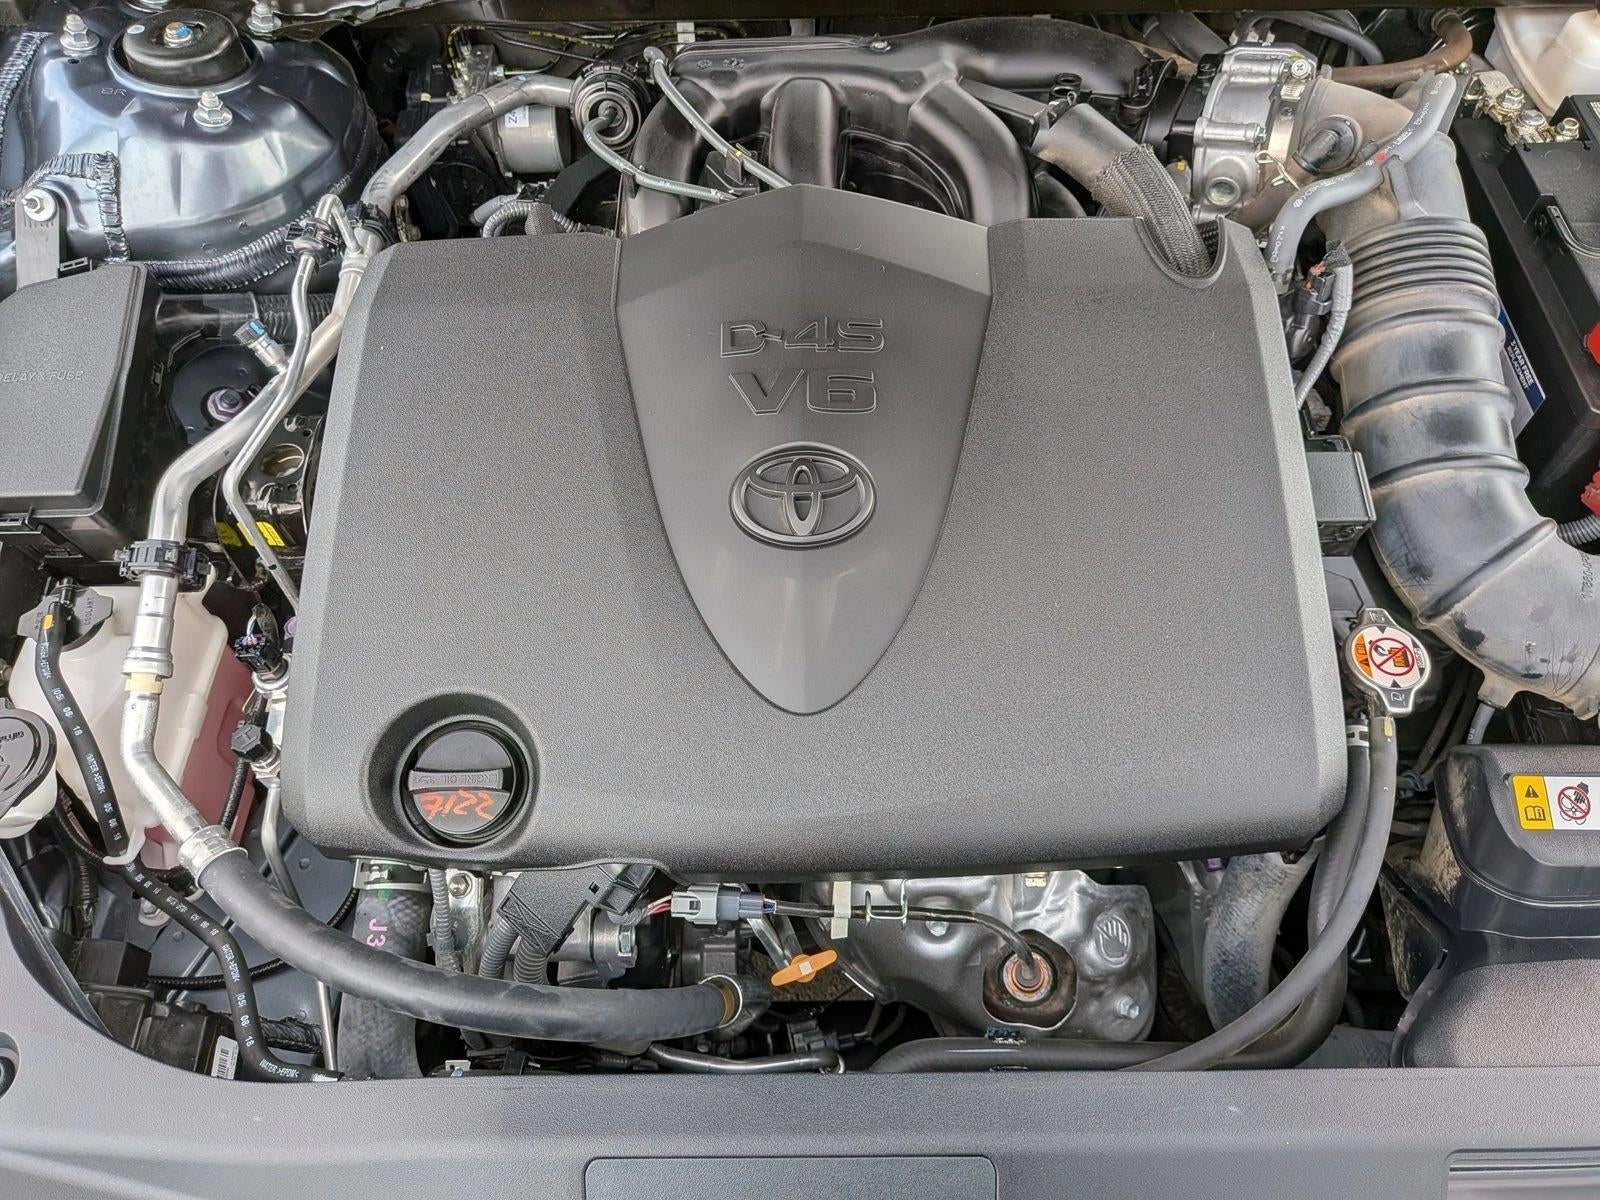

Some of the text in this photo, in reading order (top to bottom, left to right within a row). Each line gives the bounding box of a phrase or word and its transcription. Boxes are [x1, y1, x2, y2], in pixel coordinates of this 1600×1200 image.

[720, 316, 885, 358] D-4S
[50, 368, 83, 381] FUSE
[1506, 345, 1528, 390] REPLACEMENT
[1513, 344, 1526, 366] YEAR
[1521, 364, 1535, 387] FREE
[729, 368, 876, 416] V6
[83, 597, 96, 627] COOLANT
[72, 725, 83, 736] 18
[366, 917, 388, 947] J3
[221, 943, 235, 962] WATER
[244, 1035, 255, 1048] 18
[259, 1058, 278, 1075] WATER
